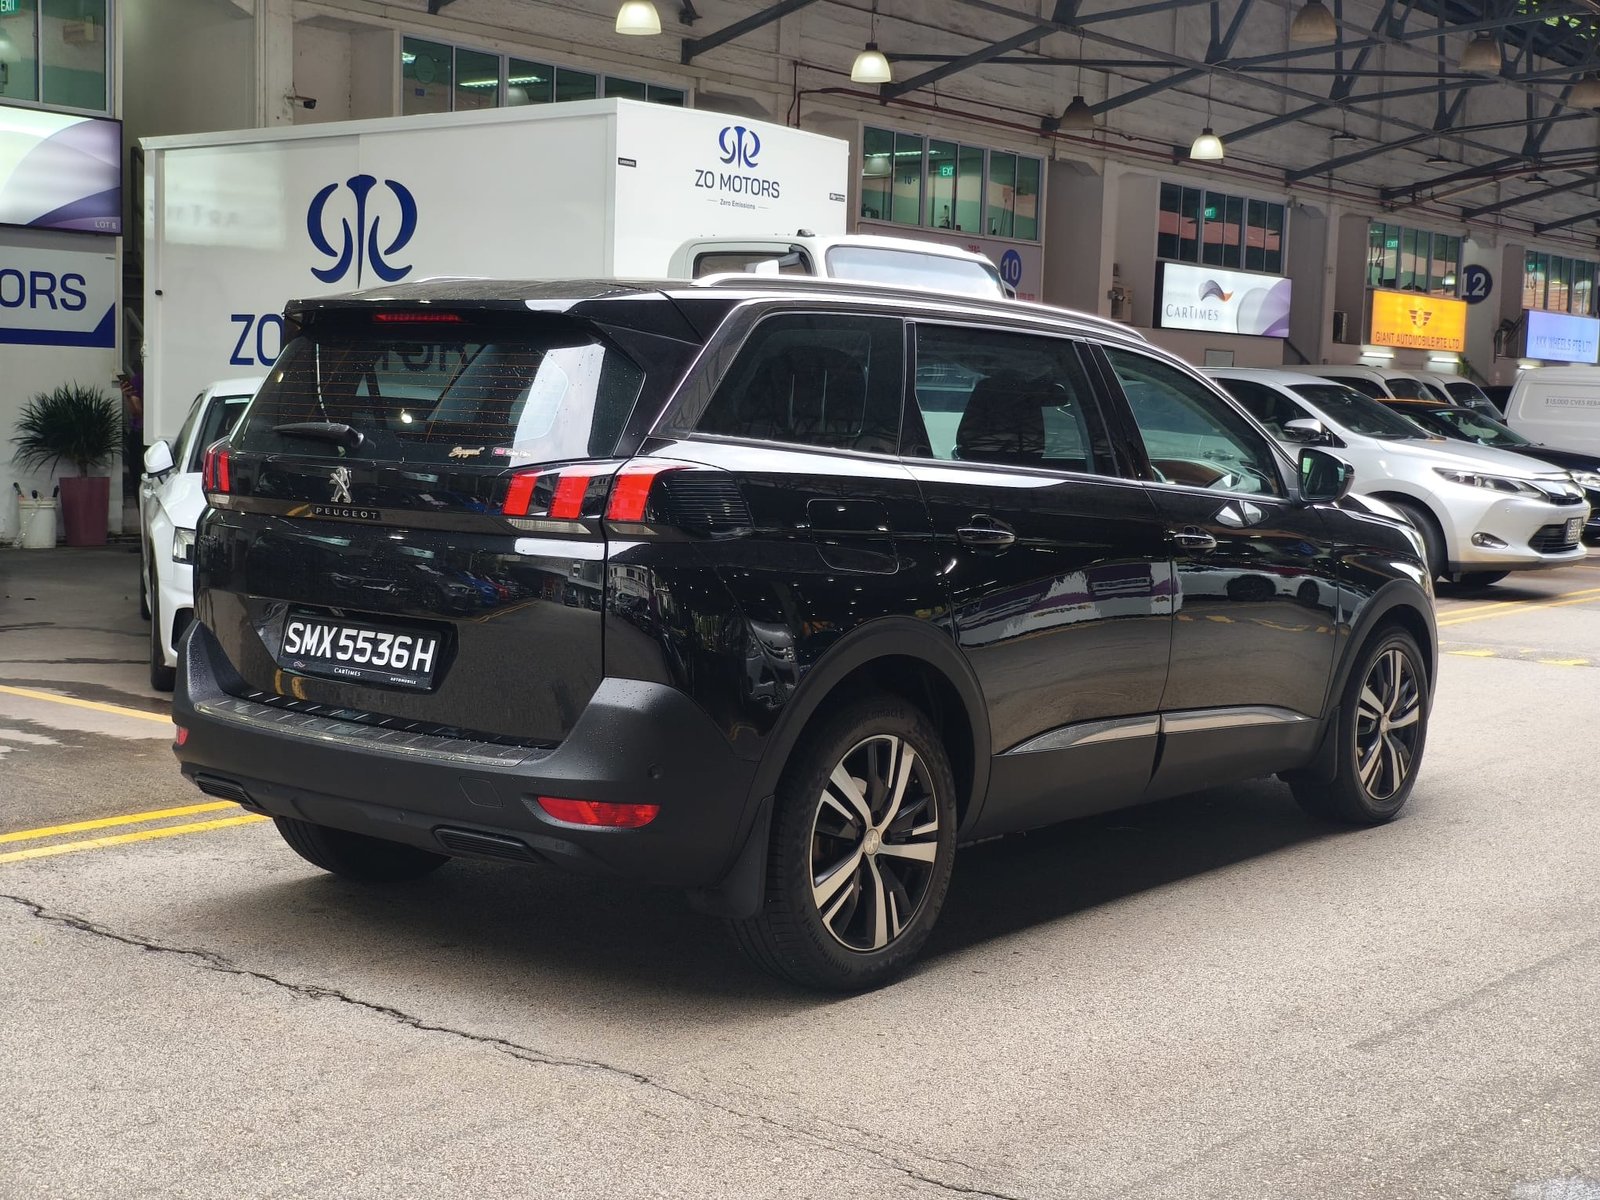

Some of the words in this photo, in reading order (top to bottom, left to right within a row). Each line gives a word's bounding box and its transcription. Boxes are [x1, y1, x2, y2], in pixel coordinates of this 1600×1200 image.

[695, 169, 715, 188] ZO
[719, 173, 780, 198] MOTORS
[732, 200, 756, 210] Emissions
[1003, 257, 1019, 281] 10
[0, 268, 87, 311] ORS
[1461, 272, 1486, 297] 12
[229, 313, 285, 367] ZO
[1375, 331, 1395, 343] GIANT
[1396, 333, 1435, 347] AUTOMOBILE
[1436, 336, 1447, 348] PTE
[1448, 338, 1460, 349] LTD
[316, 507, 377, 519] PEUGEOT
[285, 622, 436, 672] SMX5536H
[390, 677, 417, 685] AUTOMOBILE
